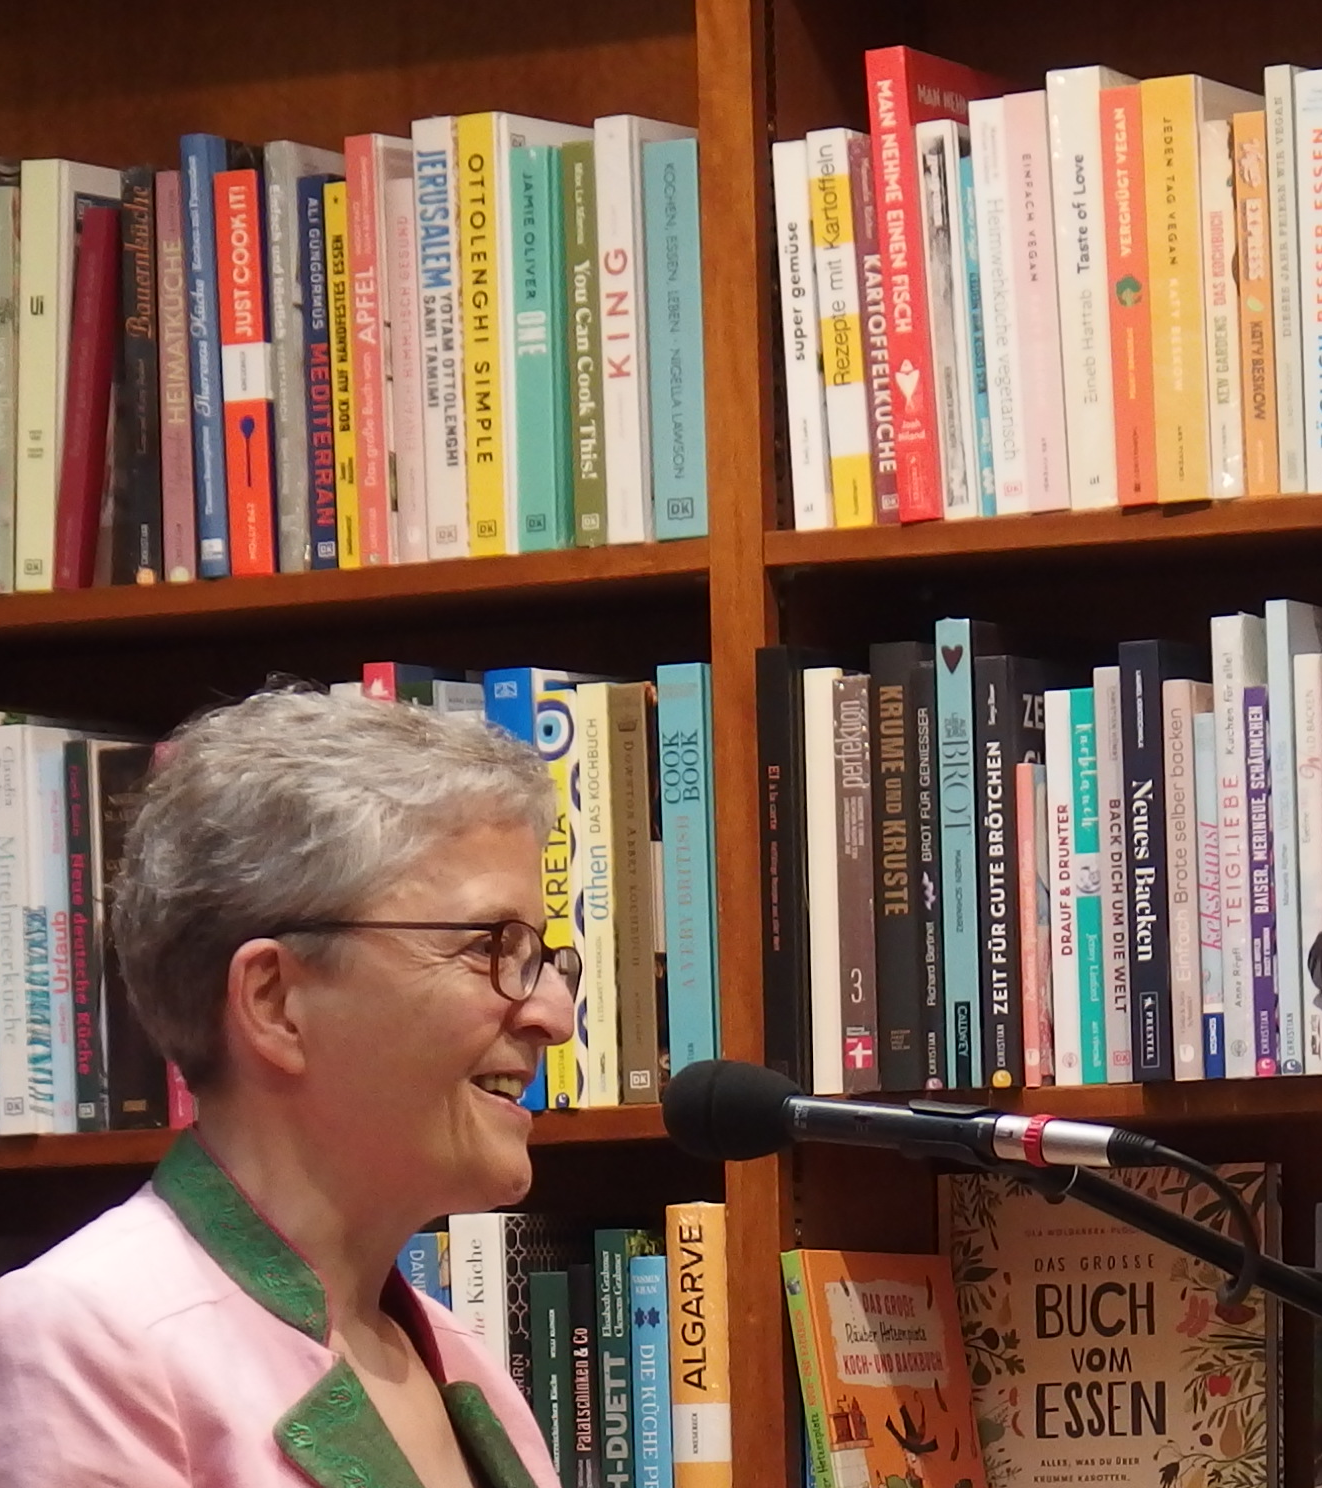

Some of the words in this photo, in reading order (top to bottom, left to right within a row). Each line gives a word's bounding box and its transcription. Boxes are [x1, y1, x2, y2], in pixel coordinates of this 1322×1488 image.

[877, 79, 896, 128] MAN
[881, 133, 902, 202] NEHME
[1074, 154, 1084, 195] Love
[229, 186, 244, 211] IT!
[417, 150, 451, 288] JERUSALEM
[523, 174, 534, 226] JAMIE
[818, 144, 841, 251] Kartoffeln
[1073, 201, 1087, 219] of
[230, 217, 250, 280] COOK
[468, 154, 487, 341] OTTOLENGHI
[525, 232, 536, 299] OLIVER
[786, 221, 800, 298] gemüse
[888, 209, 907, 267] EINEN
[1076, 225, 1090, 274] Taste
[573, 260, 591, 297] You
[829, 259, 843, 289] mit
[892, 269, 912, 334] FISCH
[233, 301, 252, 336] JUST
[424, 296, 437, 341] SAMI
[442, 292, 455, 350] YOTAM
[518, 311, 546, 355] ONE
[574, 305, 592, 350] Can
[604, 248, 631, 379] KING
[793, 306, 806, 361] super
[833, 301, 851, 386] Rezepte
[864, 254, 897, 474] KARTOFFELKÜCHE
[426, 348, 440, 407] TAMIMI
[577, 356, 593, 415] Cook
[311, 342, 335, 526] MEDITERRAN
[444, 356, 459, 467] OTTOLENGHI
[475, 363, 493, 463] SIMPLE
[578, 419, 598, 480] This!
[588, 718, 598, 797] KOCHBUCH
[663, 733, 679, 804] COOK
[682, 730, 700, 802] BOOK
[943, 741, 971, 830] BROT
[590, 805, 600, 833] DAS
[984, 741, 1002, 860] BRÖTCHEN
[1133, 779, 1154, 860] Neues
[545, 813, 569, 921] KRETA
[990, 866, 1006, 917] GUTE
[1136, 865, 1155, 962] Backen
[988, 923, 1006, 965] FÜR
[993, 970, 1008, 1014] ZEIT
[1143, 1008, 1155, 1058] PRESTEL
[1034, 1257, 1065, 1272] DAS
[1080, 1253, 1155, 1272] GROSSE
[682, 1224, 708, 1392] ALGARVE
[1035, 1282, 1155, 1339] BUCH
[641, 1344, 656, 1374] DIE
[1071, 1347, 1132, 1373] VOM
[641, 1383, 657, 1450] KÜCHE
[1036, 1381, 1166, 1439] ESSEN
